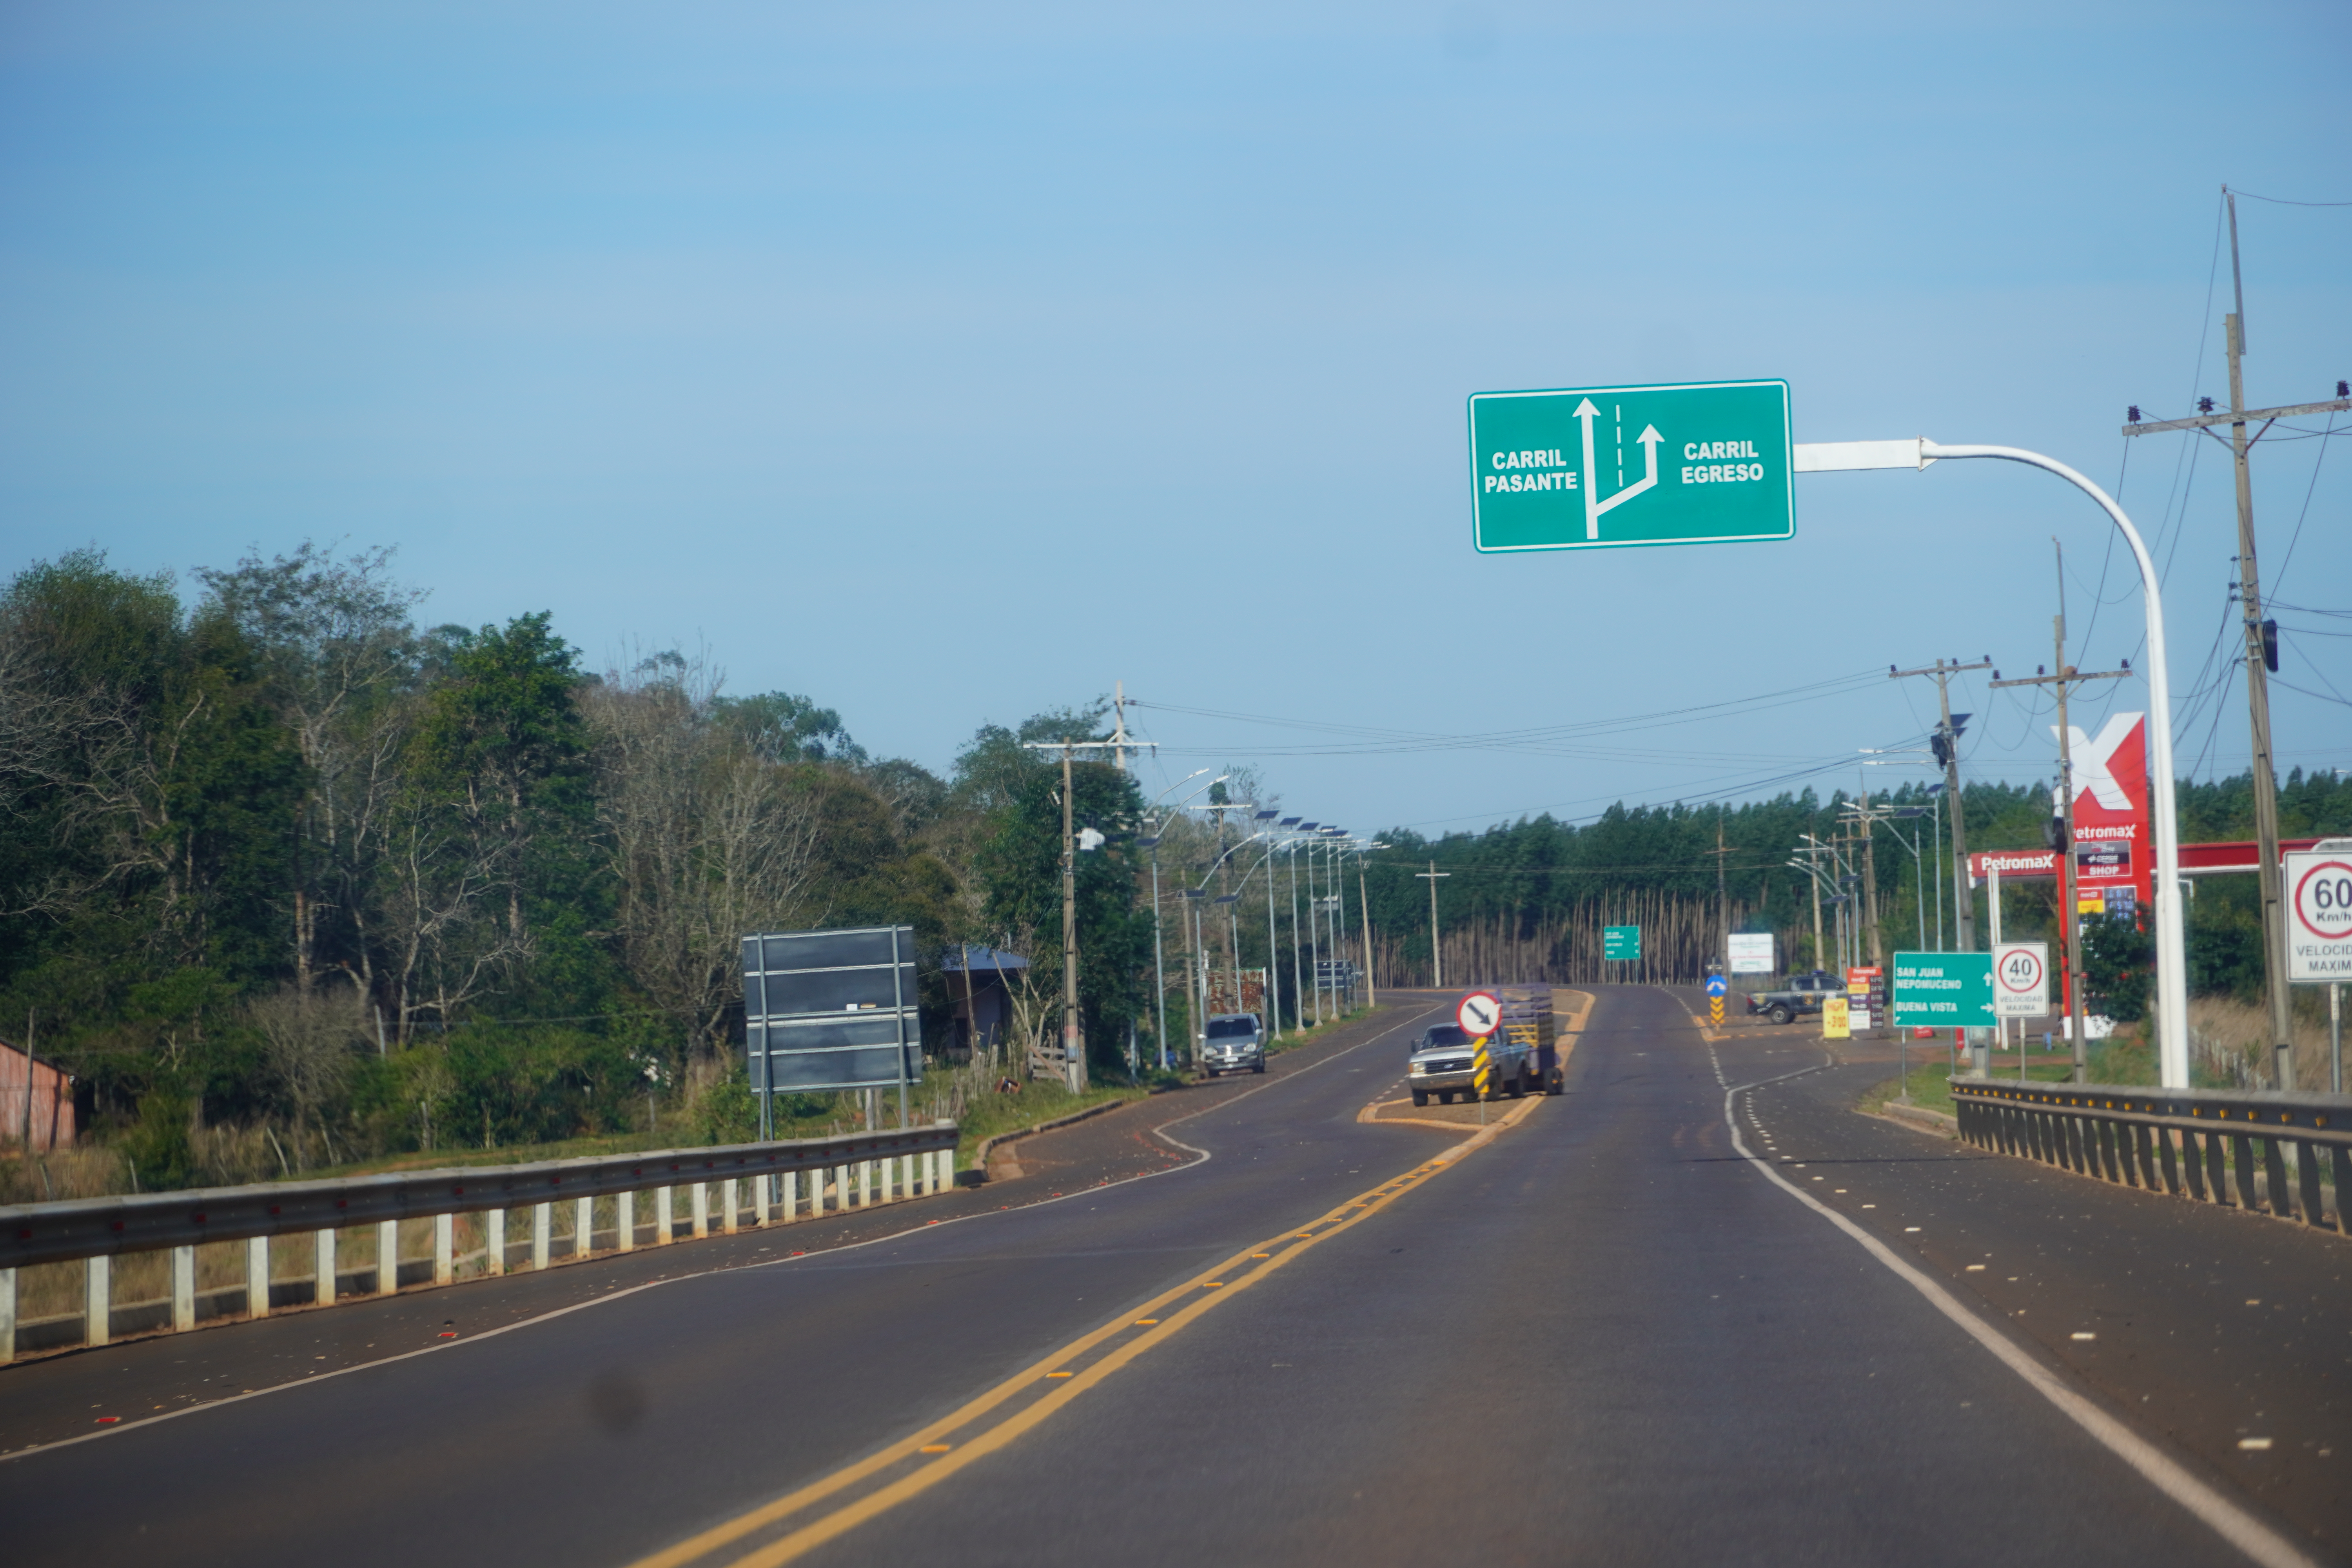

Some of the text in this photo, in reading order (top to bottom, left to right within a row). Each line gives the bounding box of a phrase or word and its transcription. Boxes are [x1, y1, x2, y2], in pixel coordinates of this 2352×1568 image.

[1684, 440, 1759, 460] CARRIL
[1492, 449, 1567, 470] CARRIL
[1681, 463, 1764, 484] EGRESO
[1485, 472, 1577, 493] PASANTE
[2073, 824, 2136, 838] etromax
[2089, 866, 2119, 875] SHOP
[2314, 878, 2352, 909] 60
[2317, 911, 2351, 921] Km/h
[1896, 967, 1944, 977] SAN JUAN
[2009, 959, 2032, 976] 40
[2309, 960, 2352, 971] MAXIM
[1896, 979, 1962, 989] NEPOMUCENO
[1896, 1002, 1958, 1012] BUENA VISTA
